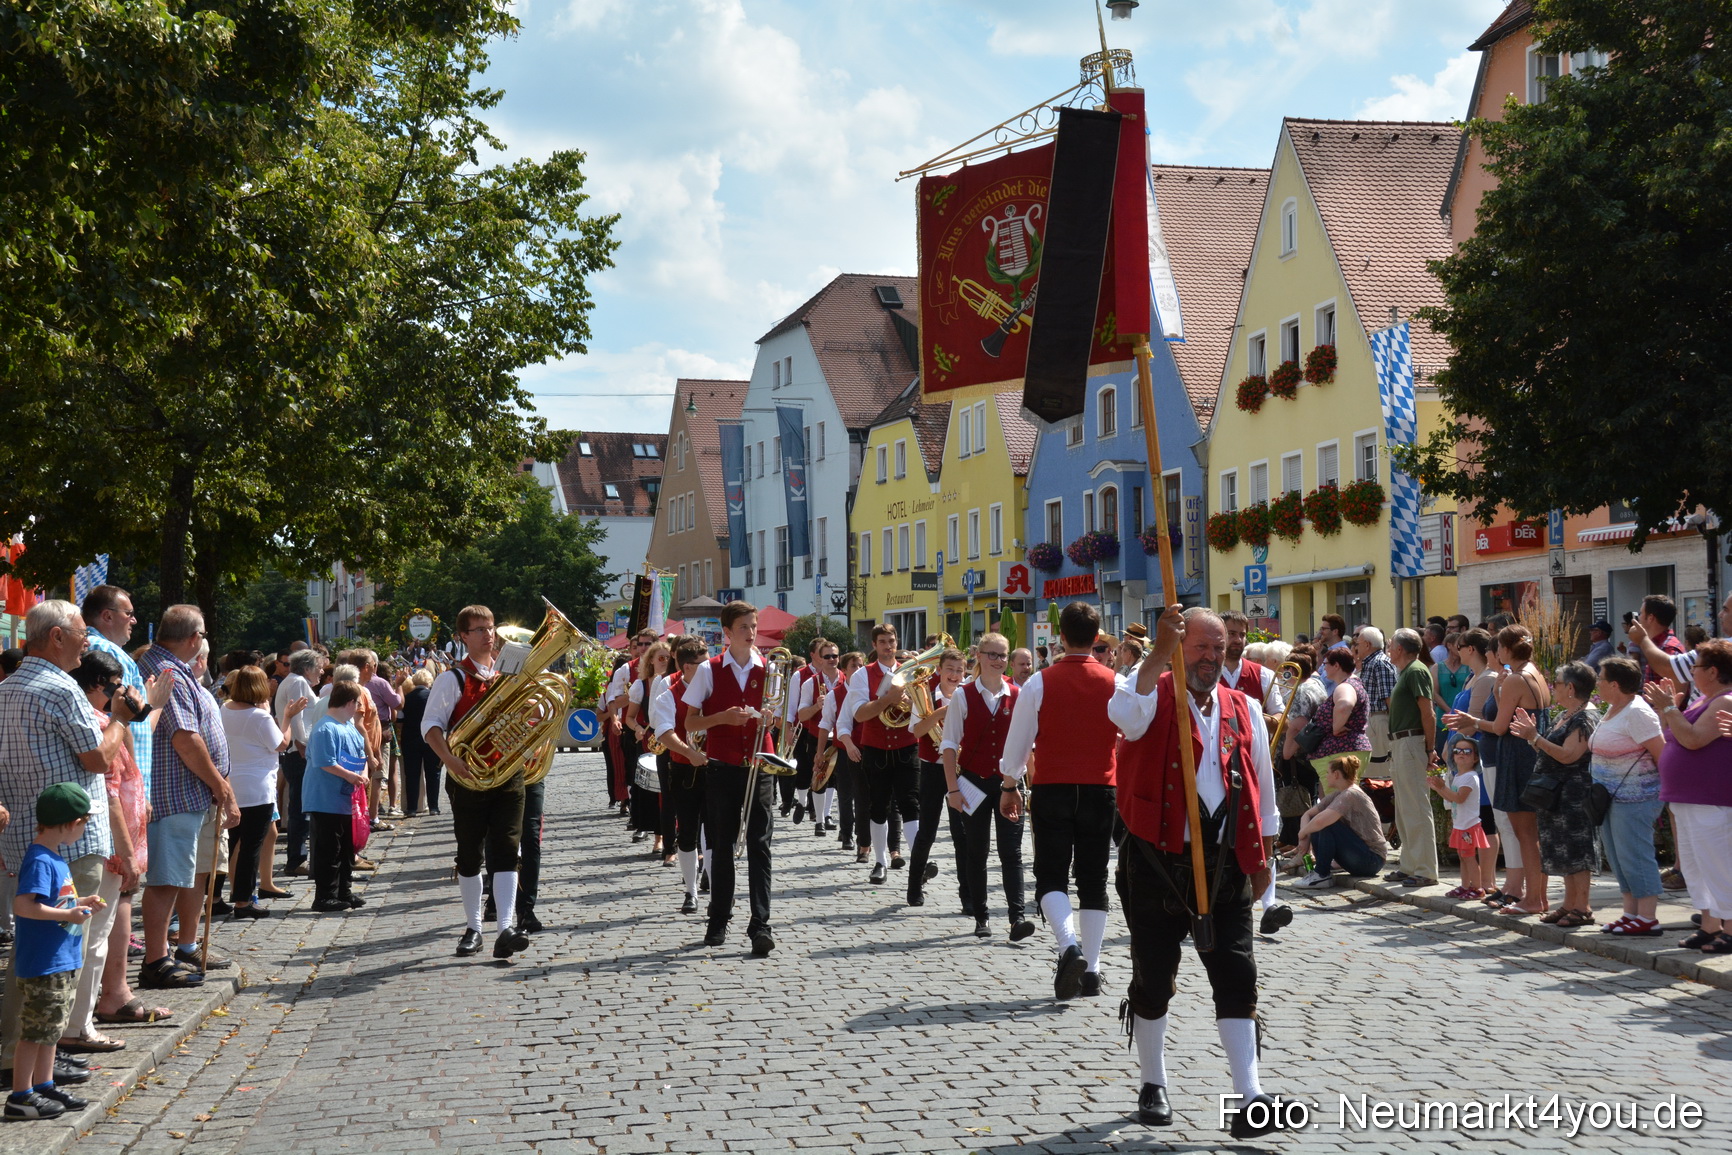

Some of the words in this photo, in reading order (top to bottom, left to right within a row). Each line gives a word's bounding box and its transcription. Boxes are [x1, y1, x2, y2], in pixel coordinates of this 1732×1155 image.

[961, 180, 1024, 225] verbindet
[1028, 179, 1048, 198] die
[887, 501, 907, 521] HOTEL
[912, 497, 935, 514] Lehmeier
[1186, 496, 1200, 509] CAFÉ
[1515, 527, 1537, 539] DER
[1551, 510, 1560, 540] P
[1187, 511, 1200, 571] WITTL
[1443, 515, 1452, 571] KINO
[960, 572, 981, 586] TAUN
[1042, 573, 1096, 599] APOTHEKE
[1249, 568, 1262, 592] P
[886, 592, 915, 606] Restaurant
